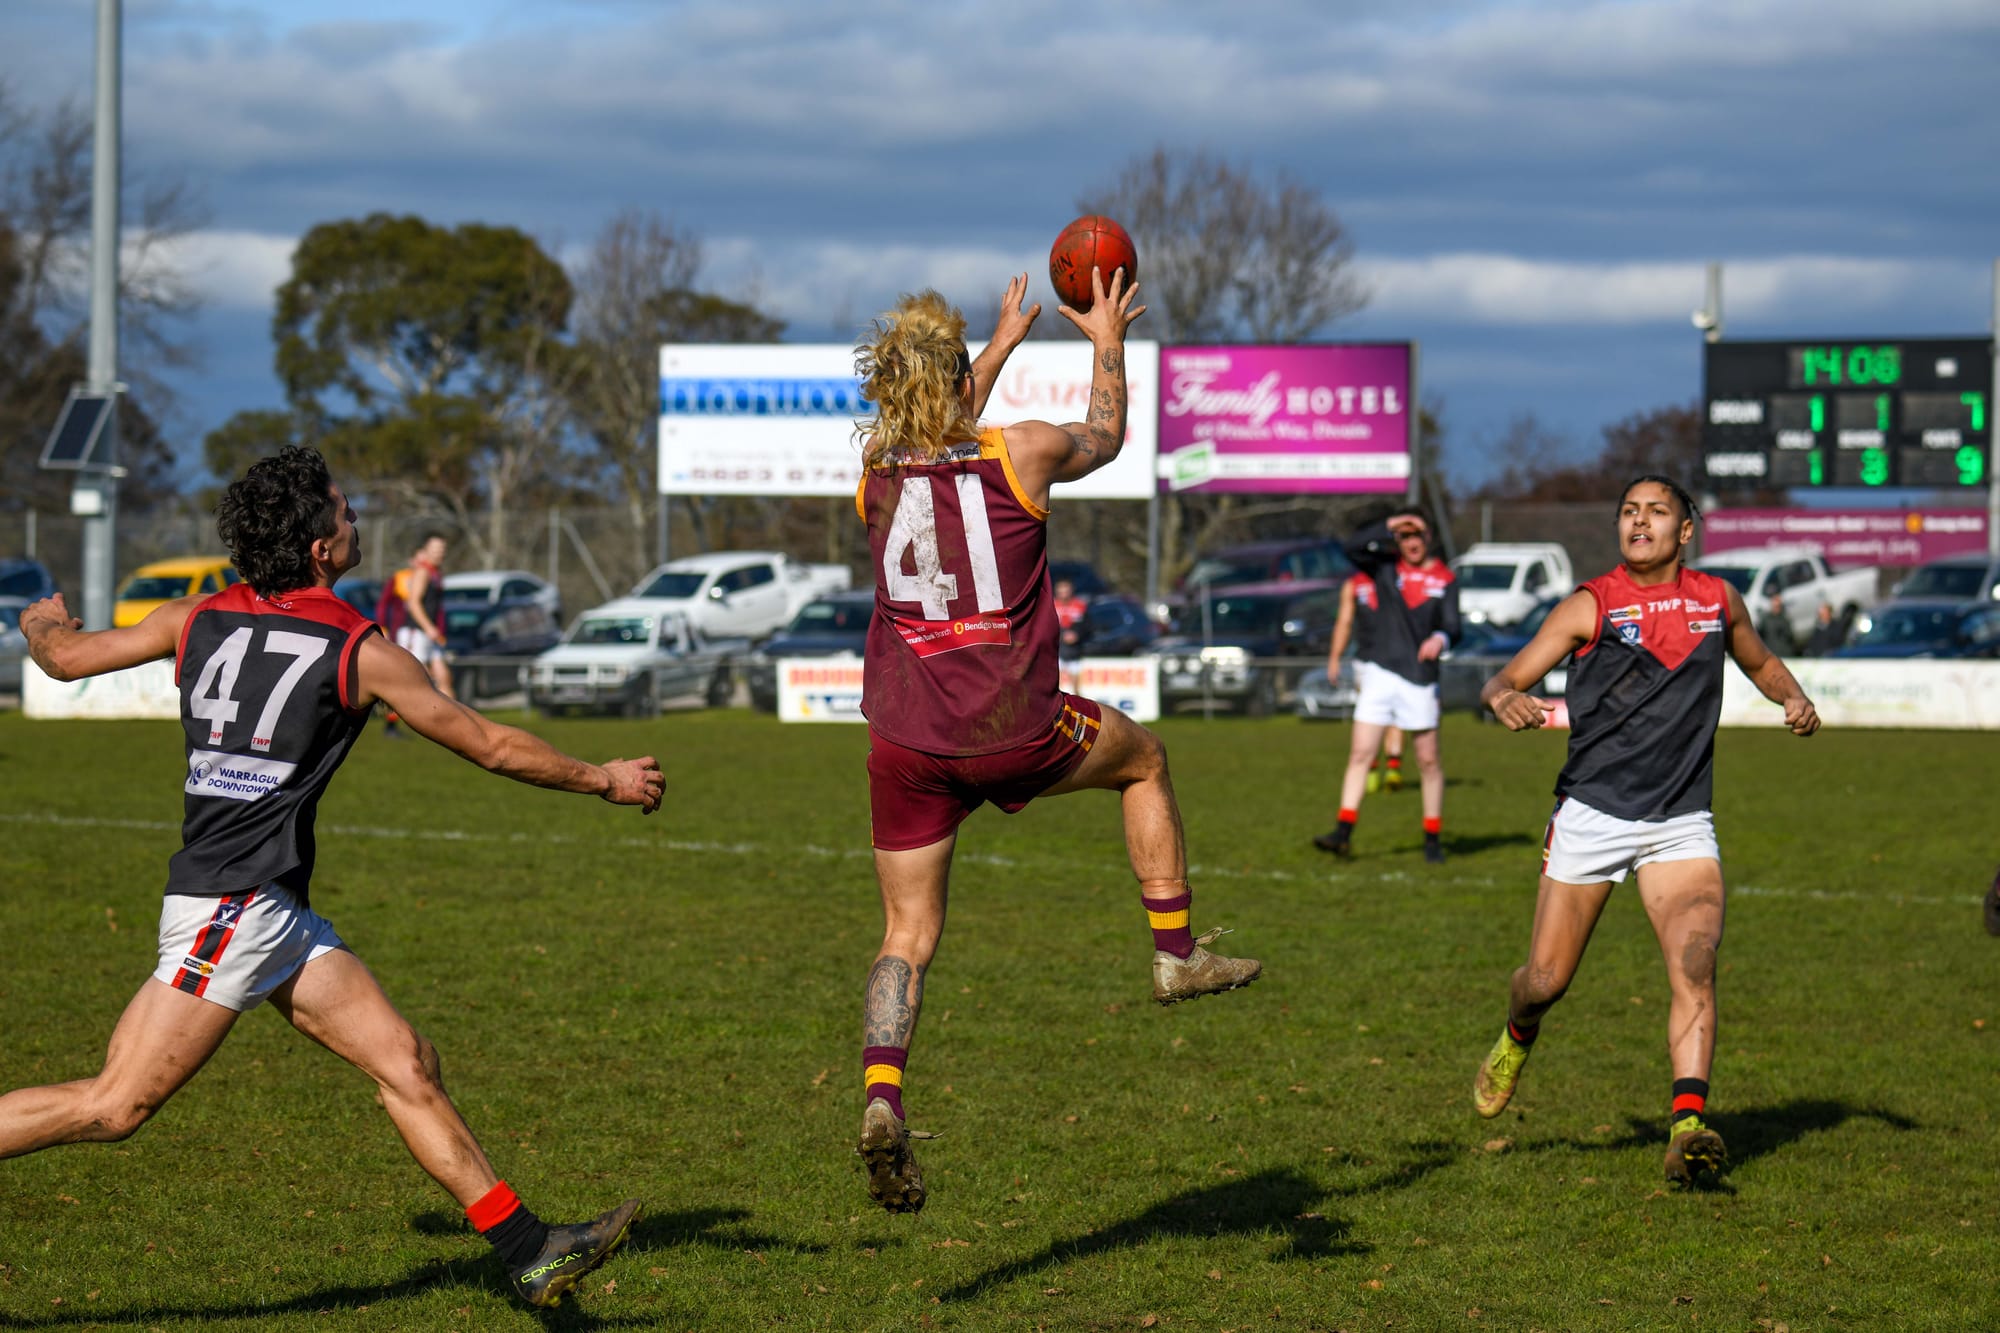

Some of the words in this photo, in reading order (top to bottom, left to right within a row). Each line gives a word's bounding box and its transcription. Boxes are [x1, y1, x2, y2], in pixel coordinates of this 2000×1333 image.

[1165, 371, 1282, 426] Family
[1285, 385, 1402, 415] HOTEL
[883, 473, 1004, 621] 41
[1648, 598, 1682, 613] TWP
[964, 622, 991, 631] Bendigo
[190, 626, 330, 752] 47
[252, 737, 270, 746] TWP
[219, 767, 279, 785] WARRAGUL
